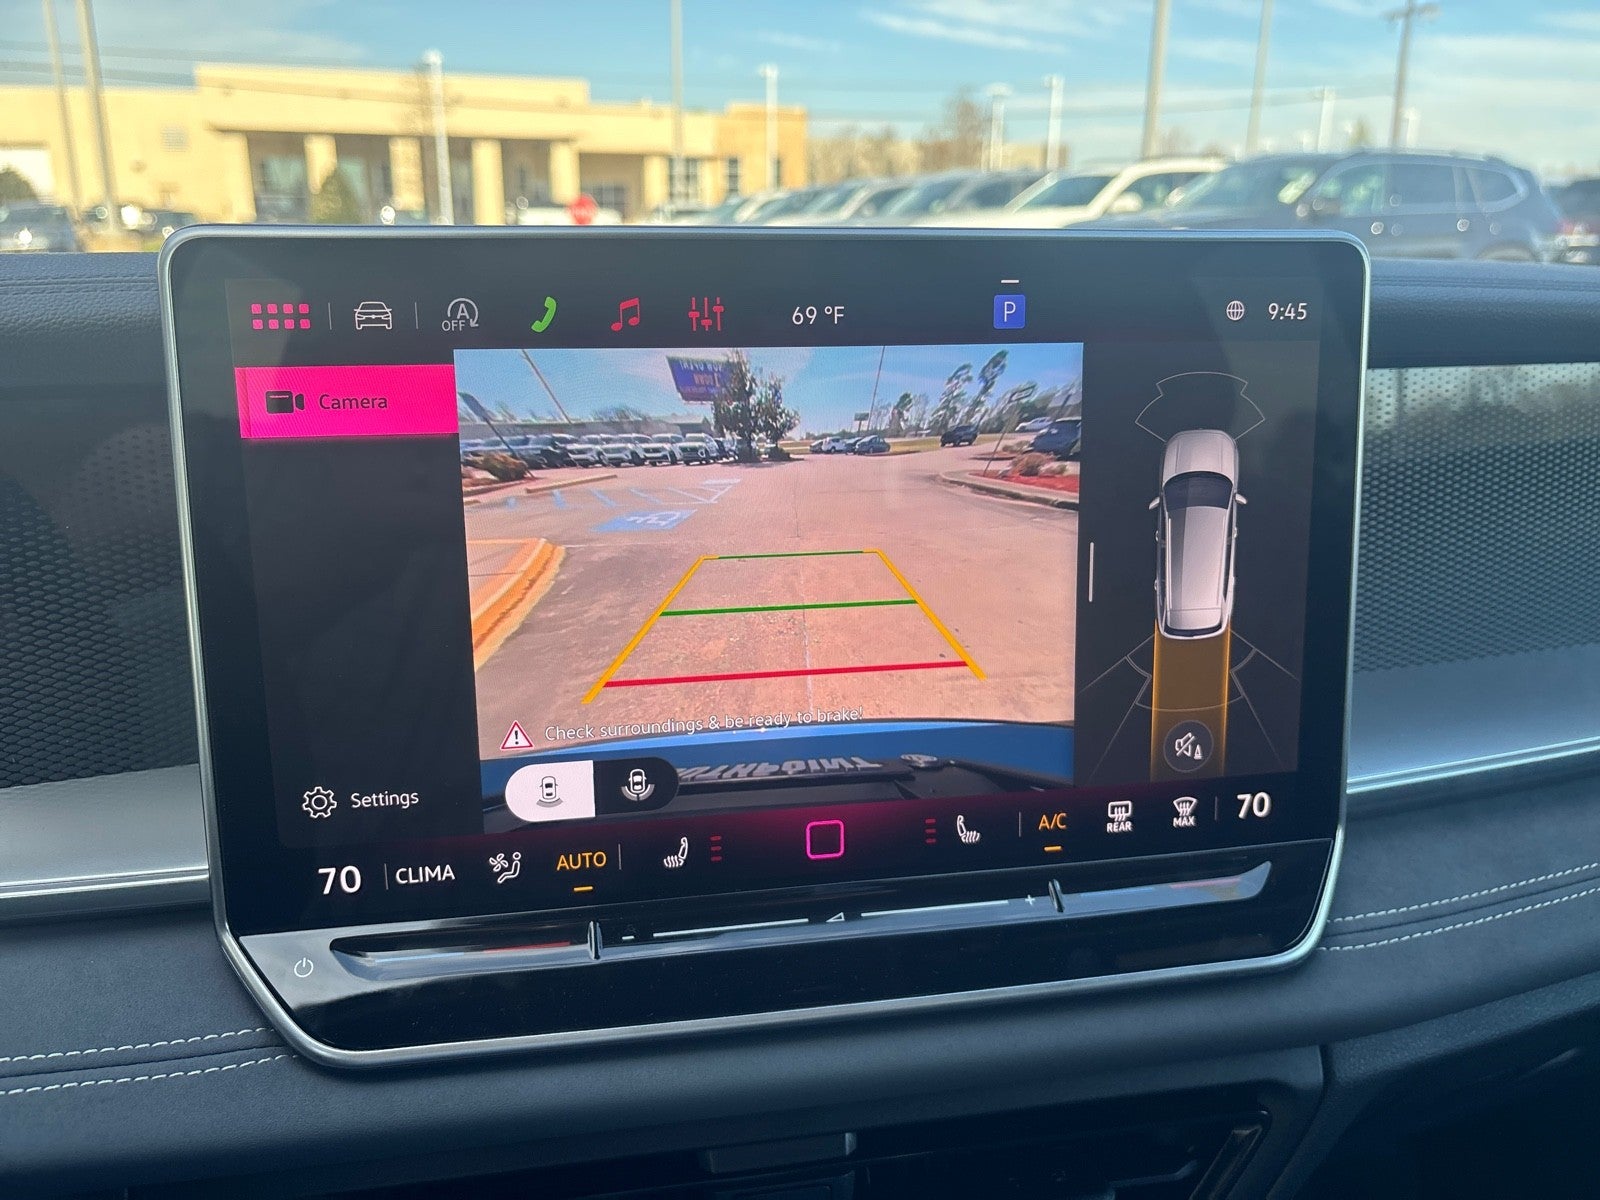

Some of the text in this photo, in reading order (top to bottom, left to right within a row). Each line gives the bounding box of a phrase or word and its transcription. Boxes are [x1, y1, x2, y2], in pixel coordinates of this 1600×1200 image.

[791, 305, 819, 326] 69
[1003, 301, 1017, 322] P
[1268, 302, 1308, 322] 9:45
[441, 320, 466, 332] OFF
[318, 393, 389, 412] Camera
[544, 705, 864, 742] Check surroundings & be ready to brake!
[350, 790, 420, 810] Settings
[1236, 791, 1272, 819] 70
[1038, 812, 1068, 831] A/C
[1106, 819, 1133, 833] REAR
[1173, 814, 1196, 828] MAX
[556, 851, 607, 871] AUTO
[318, 864, 362, 895] 70
[395, 864, 456, 885] CLIMA
